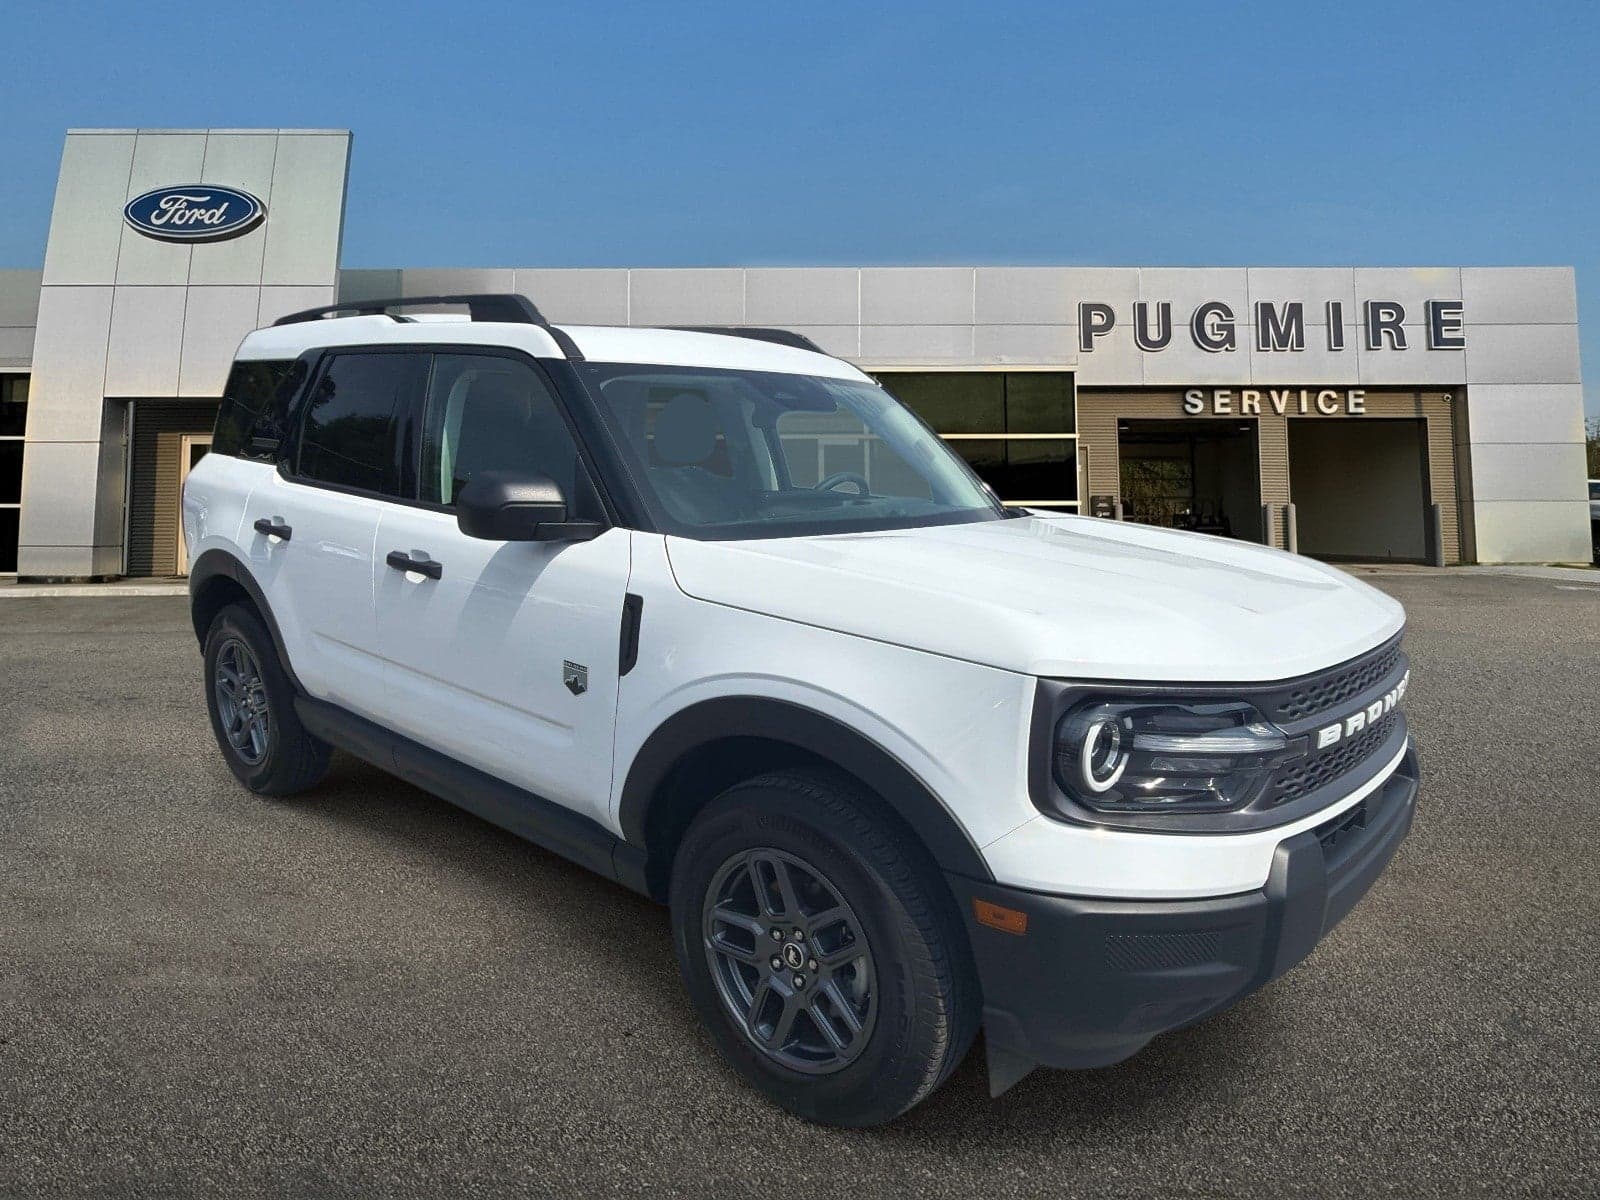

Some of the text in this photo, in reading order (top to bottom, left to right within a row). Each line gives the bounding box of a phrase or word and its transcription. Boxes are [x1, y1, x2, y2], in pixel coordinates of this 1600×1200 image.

[151, 195, 229, 225] Ford
[1078, 300, 1466, 353] PUGMIRE
[1183, 390, 1366, 415] SERVICE
[1317, 669, 1410, 749] BRONC
